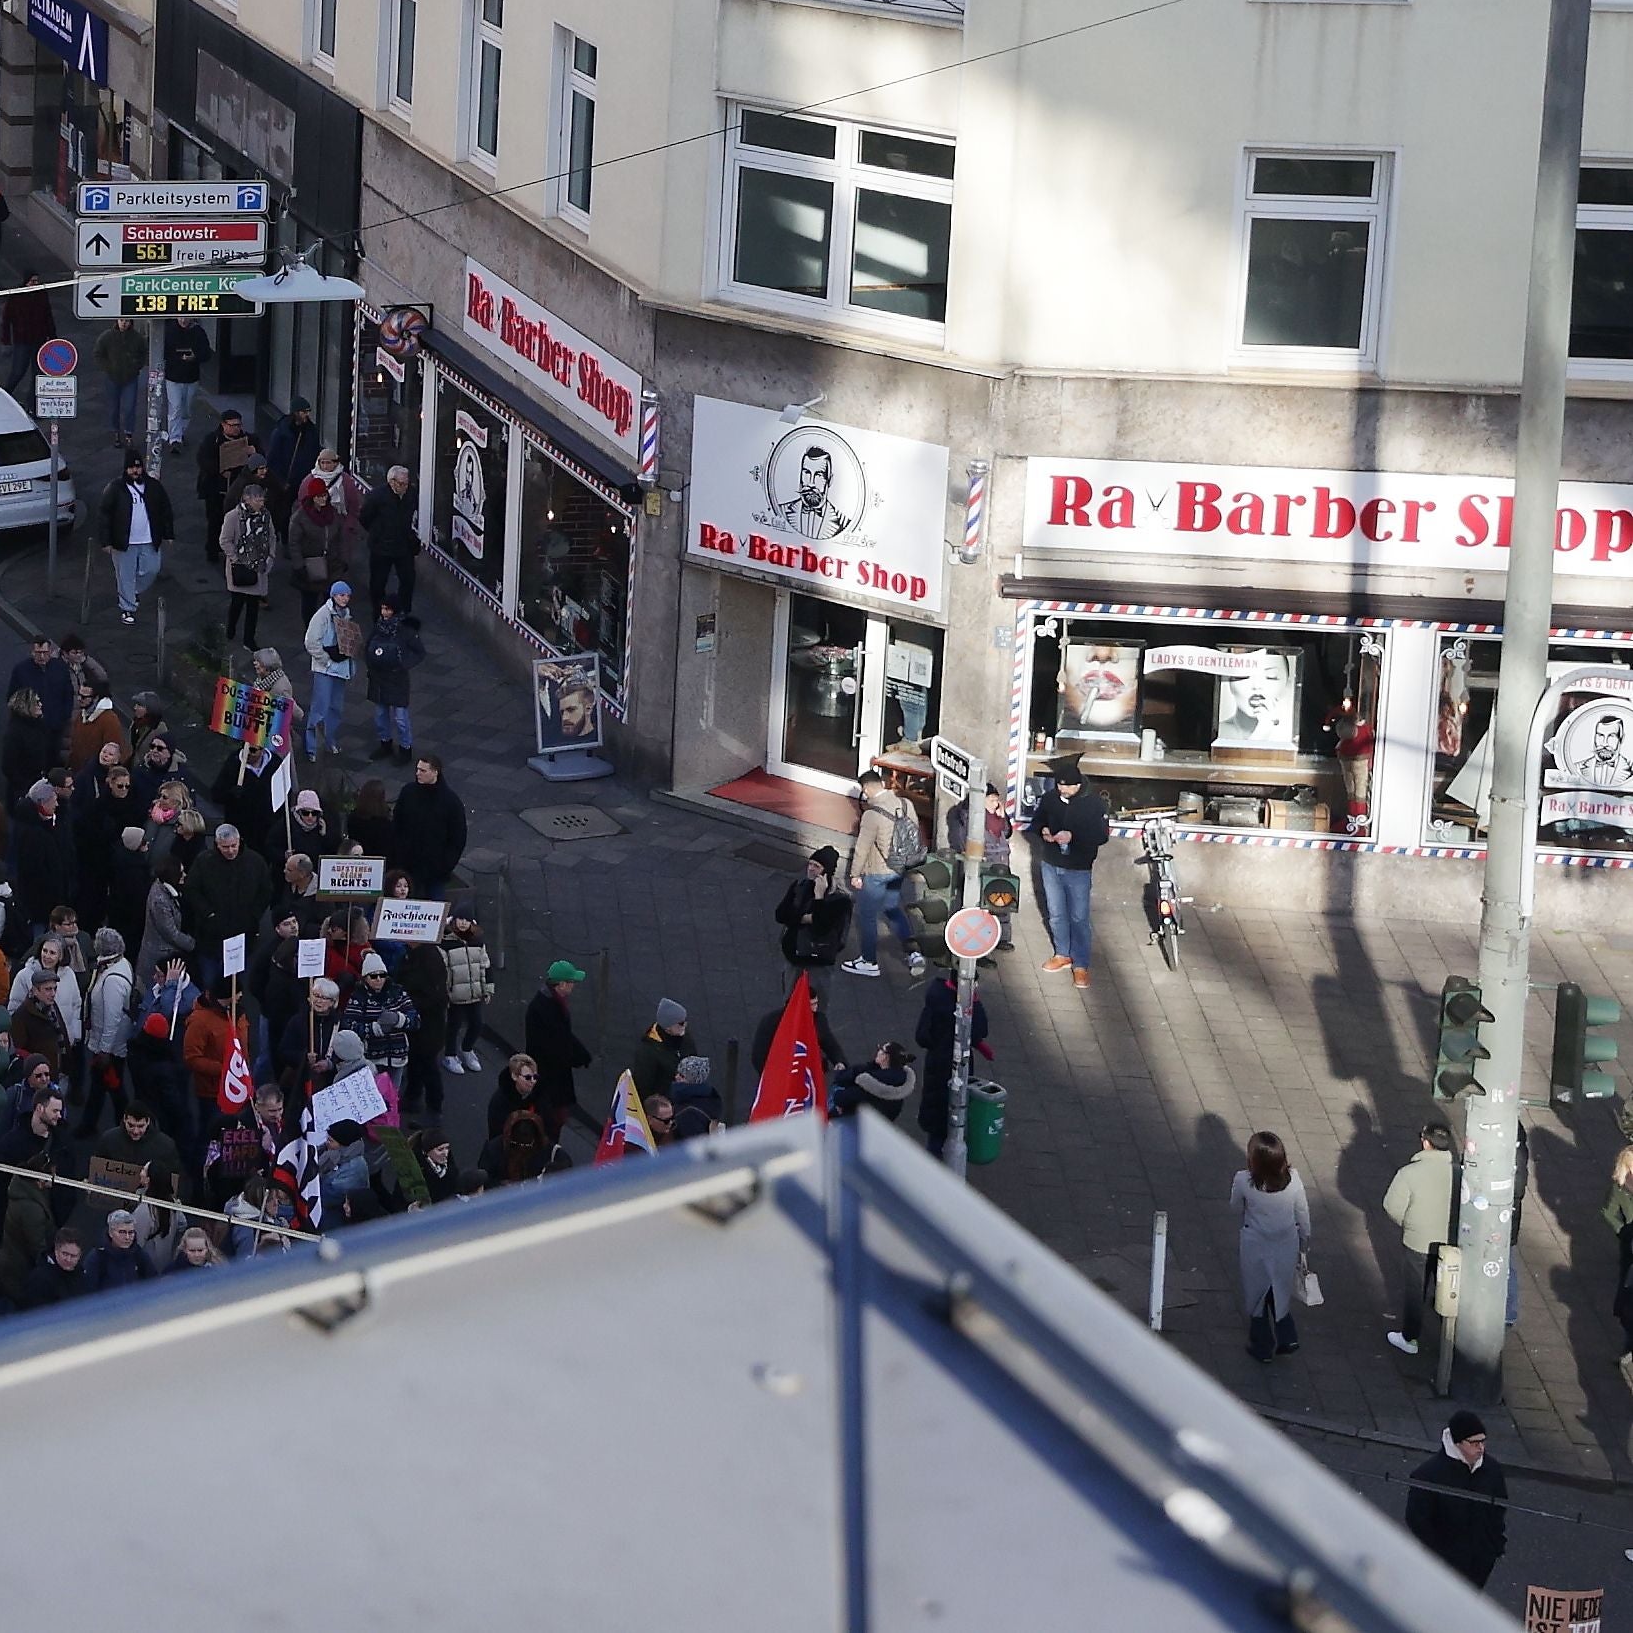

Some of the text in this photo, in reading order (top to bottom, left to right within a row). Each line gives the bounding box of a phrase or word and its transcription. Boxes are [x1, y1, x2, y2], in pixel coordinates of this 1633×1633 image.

[117, 192, 231, 207] Parkleitsystem
[126, 226, 220, 241] Schadowstr.
[136, 245, 168, 261] 561
[176, 249, 205, 262] freie
[124, 278, 211, 293] ParkCenter
[135, 296, 219, 313] 138 FREI
[467, 272, 634, 437] Ra Barber Shop
[1048, 474, 1136, 531] Ra
[1173, 480, 1436, 544] Barber
[698, 522, 926, 602] Ra Barber Shop
[1150, 652, 1185, 666] LADYS
[1197, 655, 1258, 669] GENTLEMAN
[329, 878, 372, 889] RECHTS!
[382, 909, 440, 925] Faschisten
[1529, 1592, 1566, 1623] NIE
